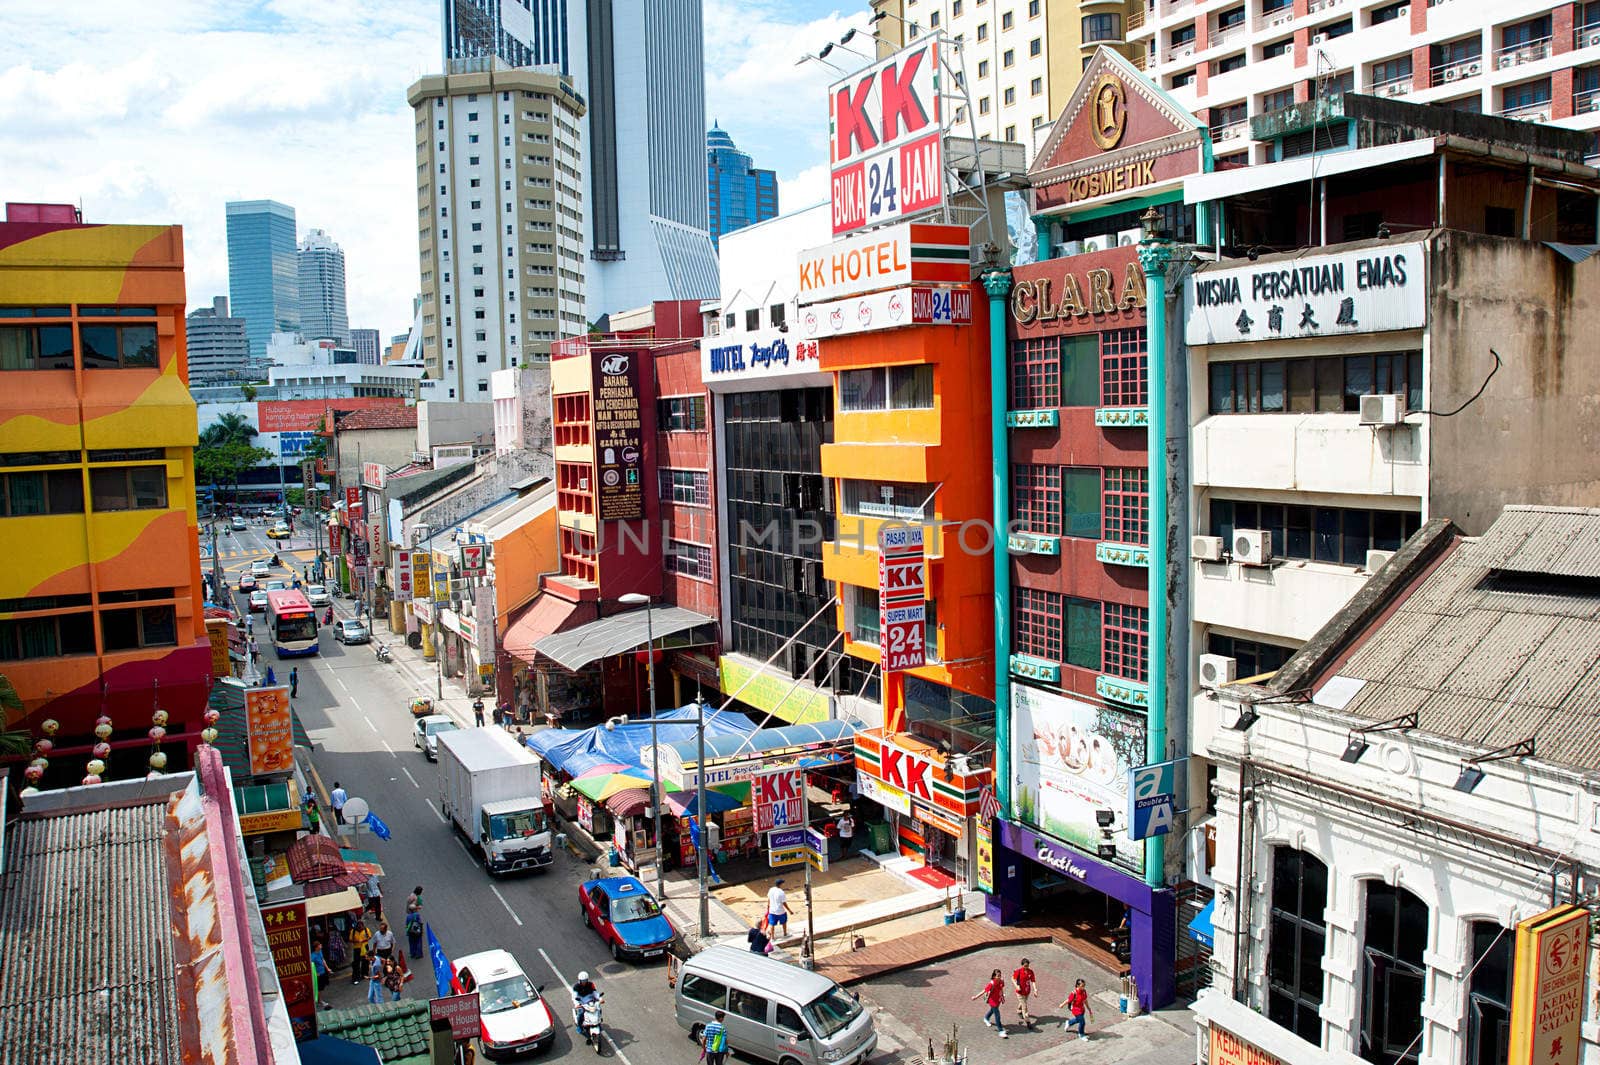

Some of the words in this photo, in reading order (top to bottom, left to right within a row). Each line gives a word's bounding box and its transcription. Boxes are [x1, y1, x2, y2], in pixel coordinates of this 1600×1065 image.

[837, 47, 930, 161] KK
[833, 165, 865, 226] BUKA
[868, 157, 897, 217] 24
[901, 147, 939, 206] JAM
[1067, 158, 1156, 202] KOSMETIK
[799, 258, 826, 292] KK
[831, 241, 907, 286] HOTEL
[1196, 276, 1242, 307] WISMA
[1252, 262, 1345, 302] PERSATUAN
[1356, 254, 1408, 292] EMAS
[913, 289, 933, 319] BUKA
[933, 287, 952, 319] 24
[951, 288, 970, 319] JAM
[1010, 262, 1148, 324] CLARA
[710, 345, 746, 374] HOTEL
[599, 387, 633, 399] PERHIASAN
[603, 376, 629, 387] BARANG
[886, 531, 906, 546] PASAR
[465, 547, 481, 567] 7
[887, 565, 923, 589] KK
[887, 609, 906, 623] SUPER
[906, 607, 924, 621] MART
[889, 624, 923, 654] 24
[890, 652, 923, 669] JAM
[761, 771, 796, 803] KK
[881, 744, 932, 802] KK
[759, 804, 774, 831] BUKA
[773, 802, 788, 826] 24
[787, 799, 803, 824] JAM
[1137, 797, 1162, 808] Double
[1163, 795, 1170, 803] A
[1037, 846, 1088, 880] Chatime
[431, 1003, 458, 1017] Reggae
[458, 1000, 471, 1011] Bar
[1539, 998, 1579, 1025] DAGING
[1542, 987, 1577, 1012] KEDAI
[455, 1014, 478, 1025] House
[1541, 1011, 1575, 1034] SALAI
[1216, 1027, 1244, 1062] KEDAI
